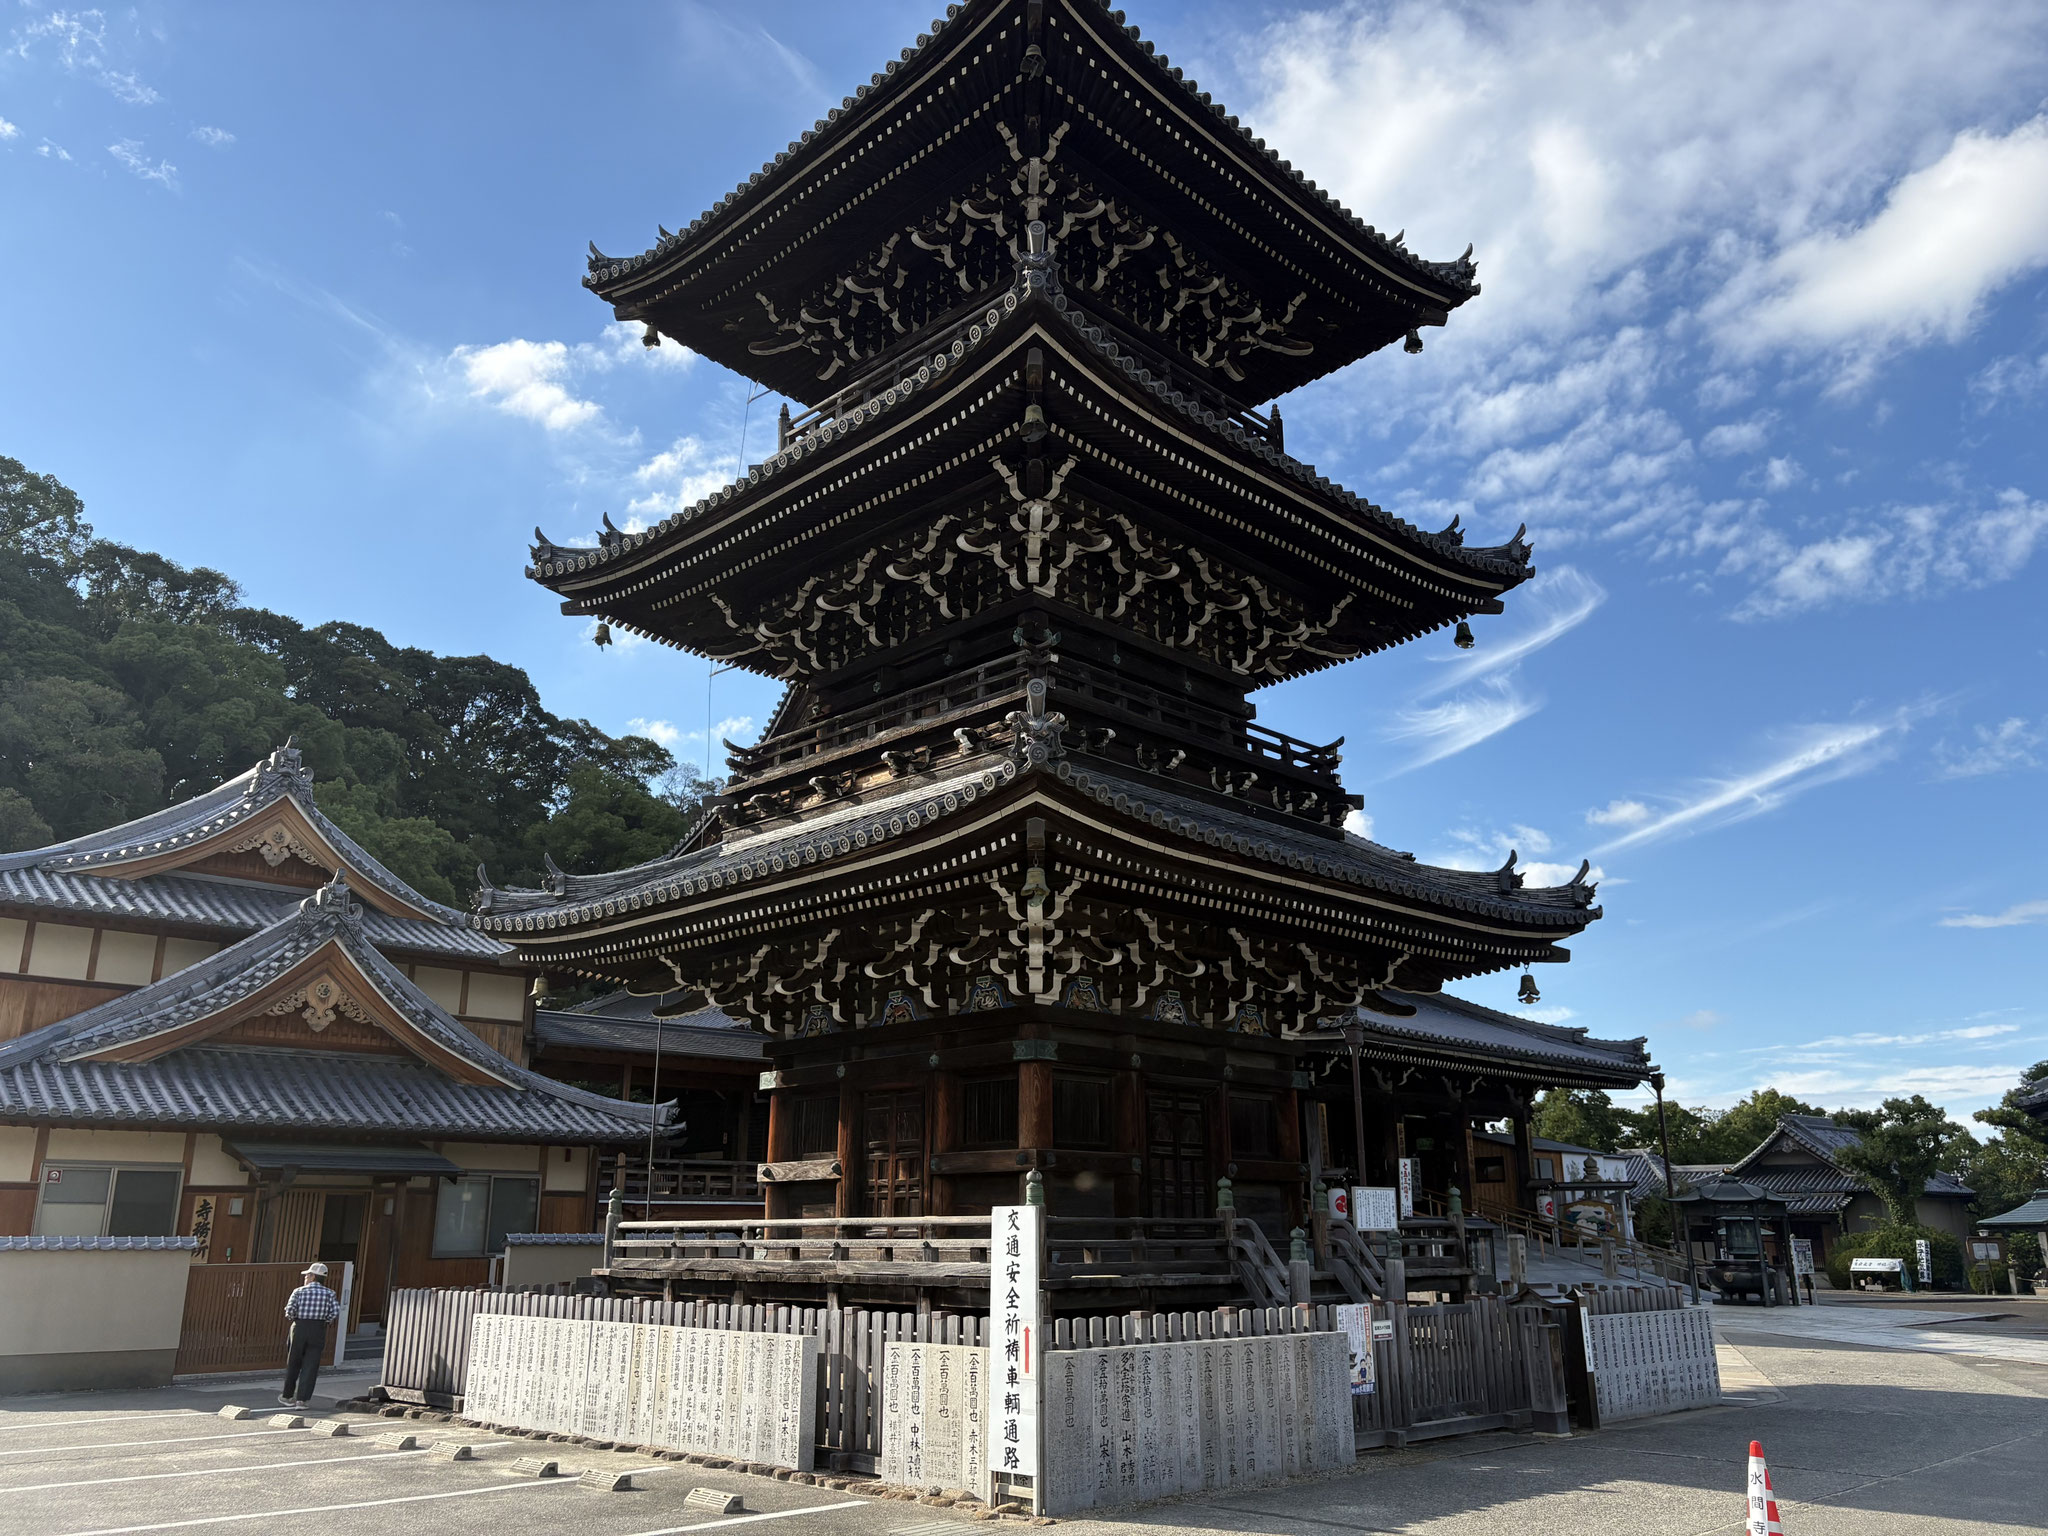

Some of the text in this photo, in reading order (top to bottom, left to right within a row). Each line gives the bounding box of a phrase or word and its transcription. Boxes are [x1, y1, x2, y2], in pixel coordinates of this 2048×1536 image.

[191, 1199, 213, 1259] 寺務所
[1750, 1472, 1766, 1535] 水間寺
